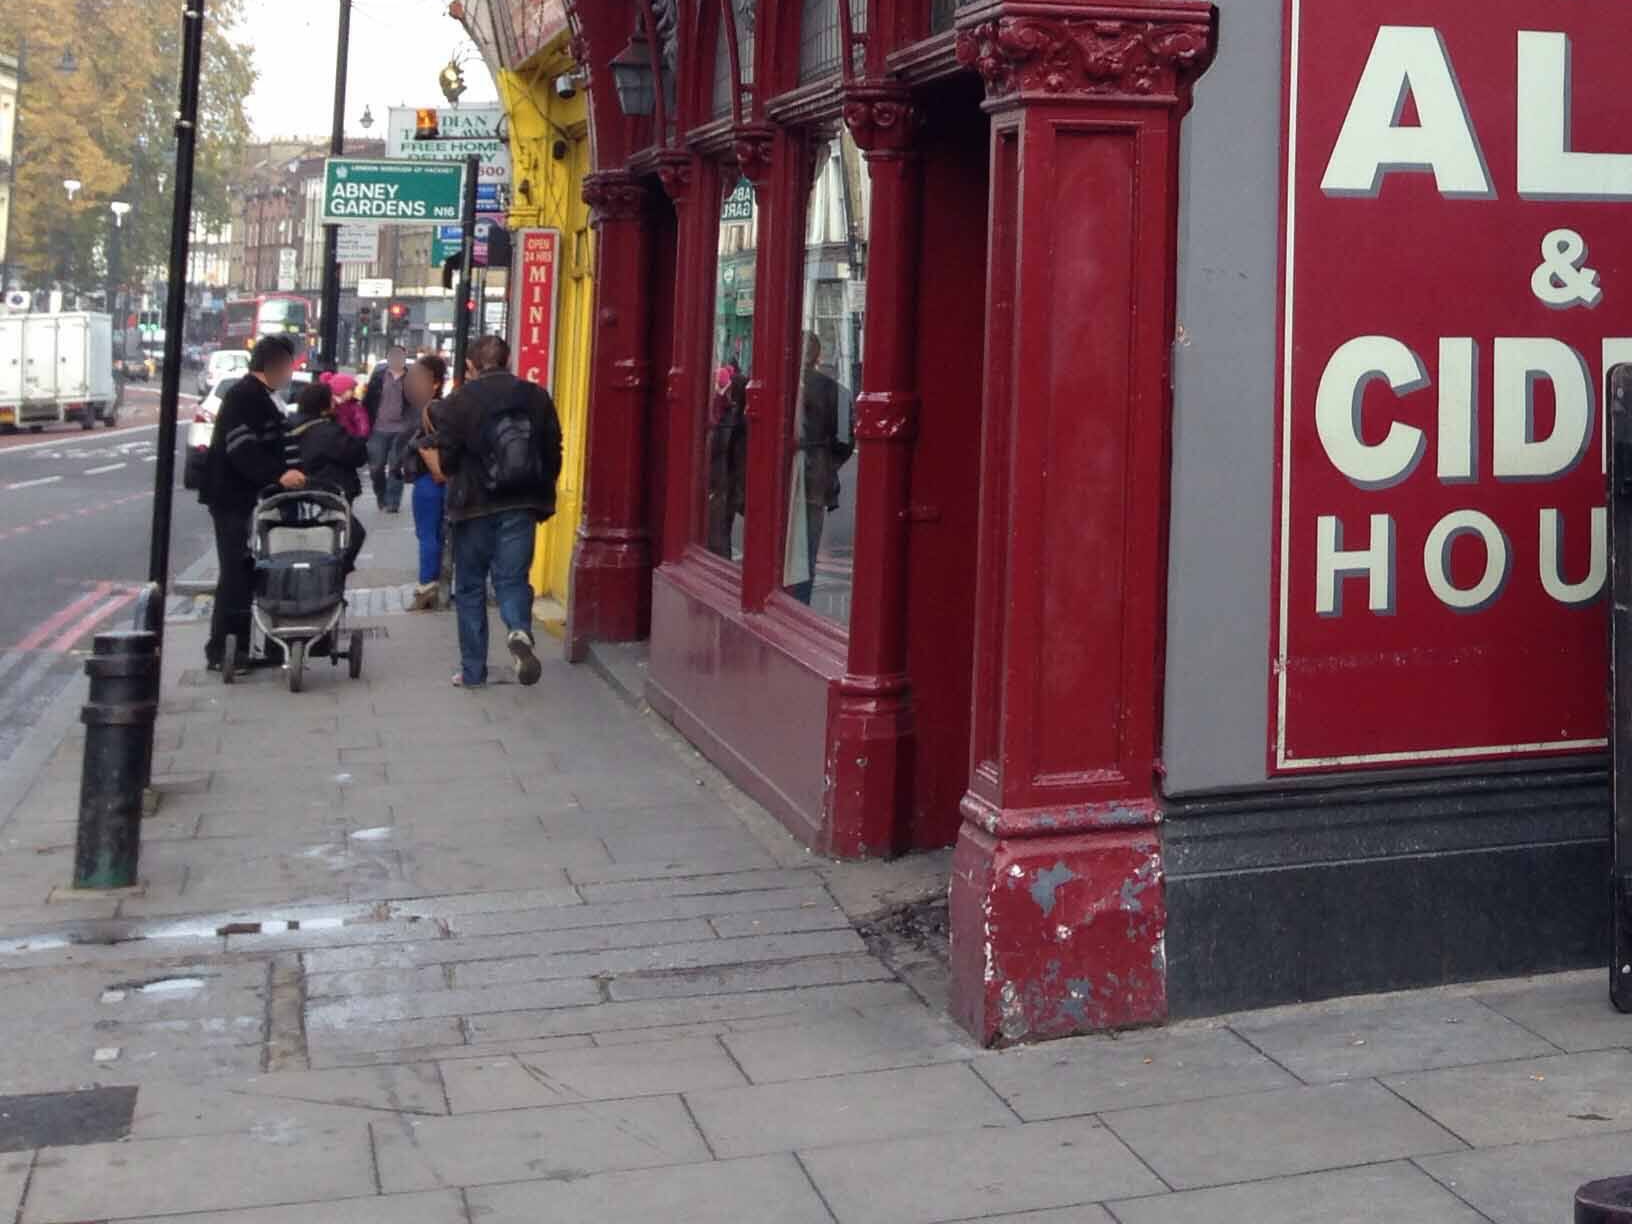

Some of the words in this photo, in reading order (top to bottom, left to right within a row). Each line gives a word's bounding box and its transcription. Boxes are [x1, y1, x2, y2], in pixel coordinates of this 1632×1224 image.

[442, 115, 487, 128] DIAN
[401, 142, 447, 152] FREE
[451, 142, 504, 152] HOME
[332, 182, 399, 198] ABNEY
[330, 199, 426, 216] GARDENS
[434, 206, 455, 216] N16
[1531, 228, 1602, 309] &
[1315, 507, 1607, 617] HOU
